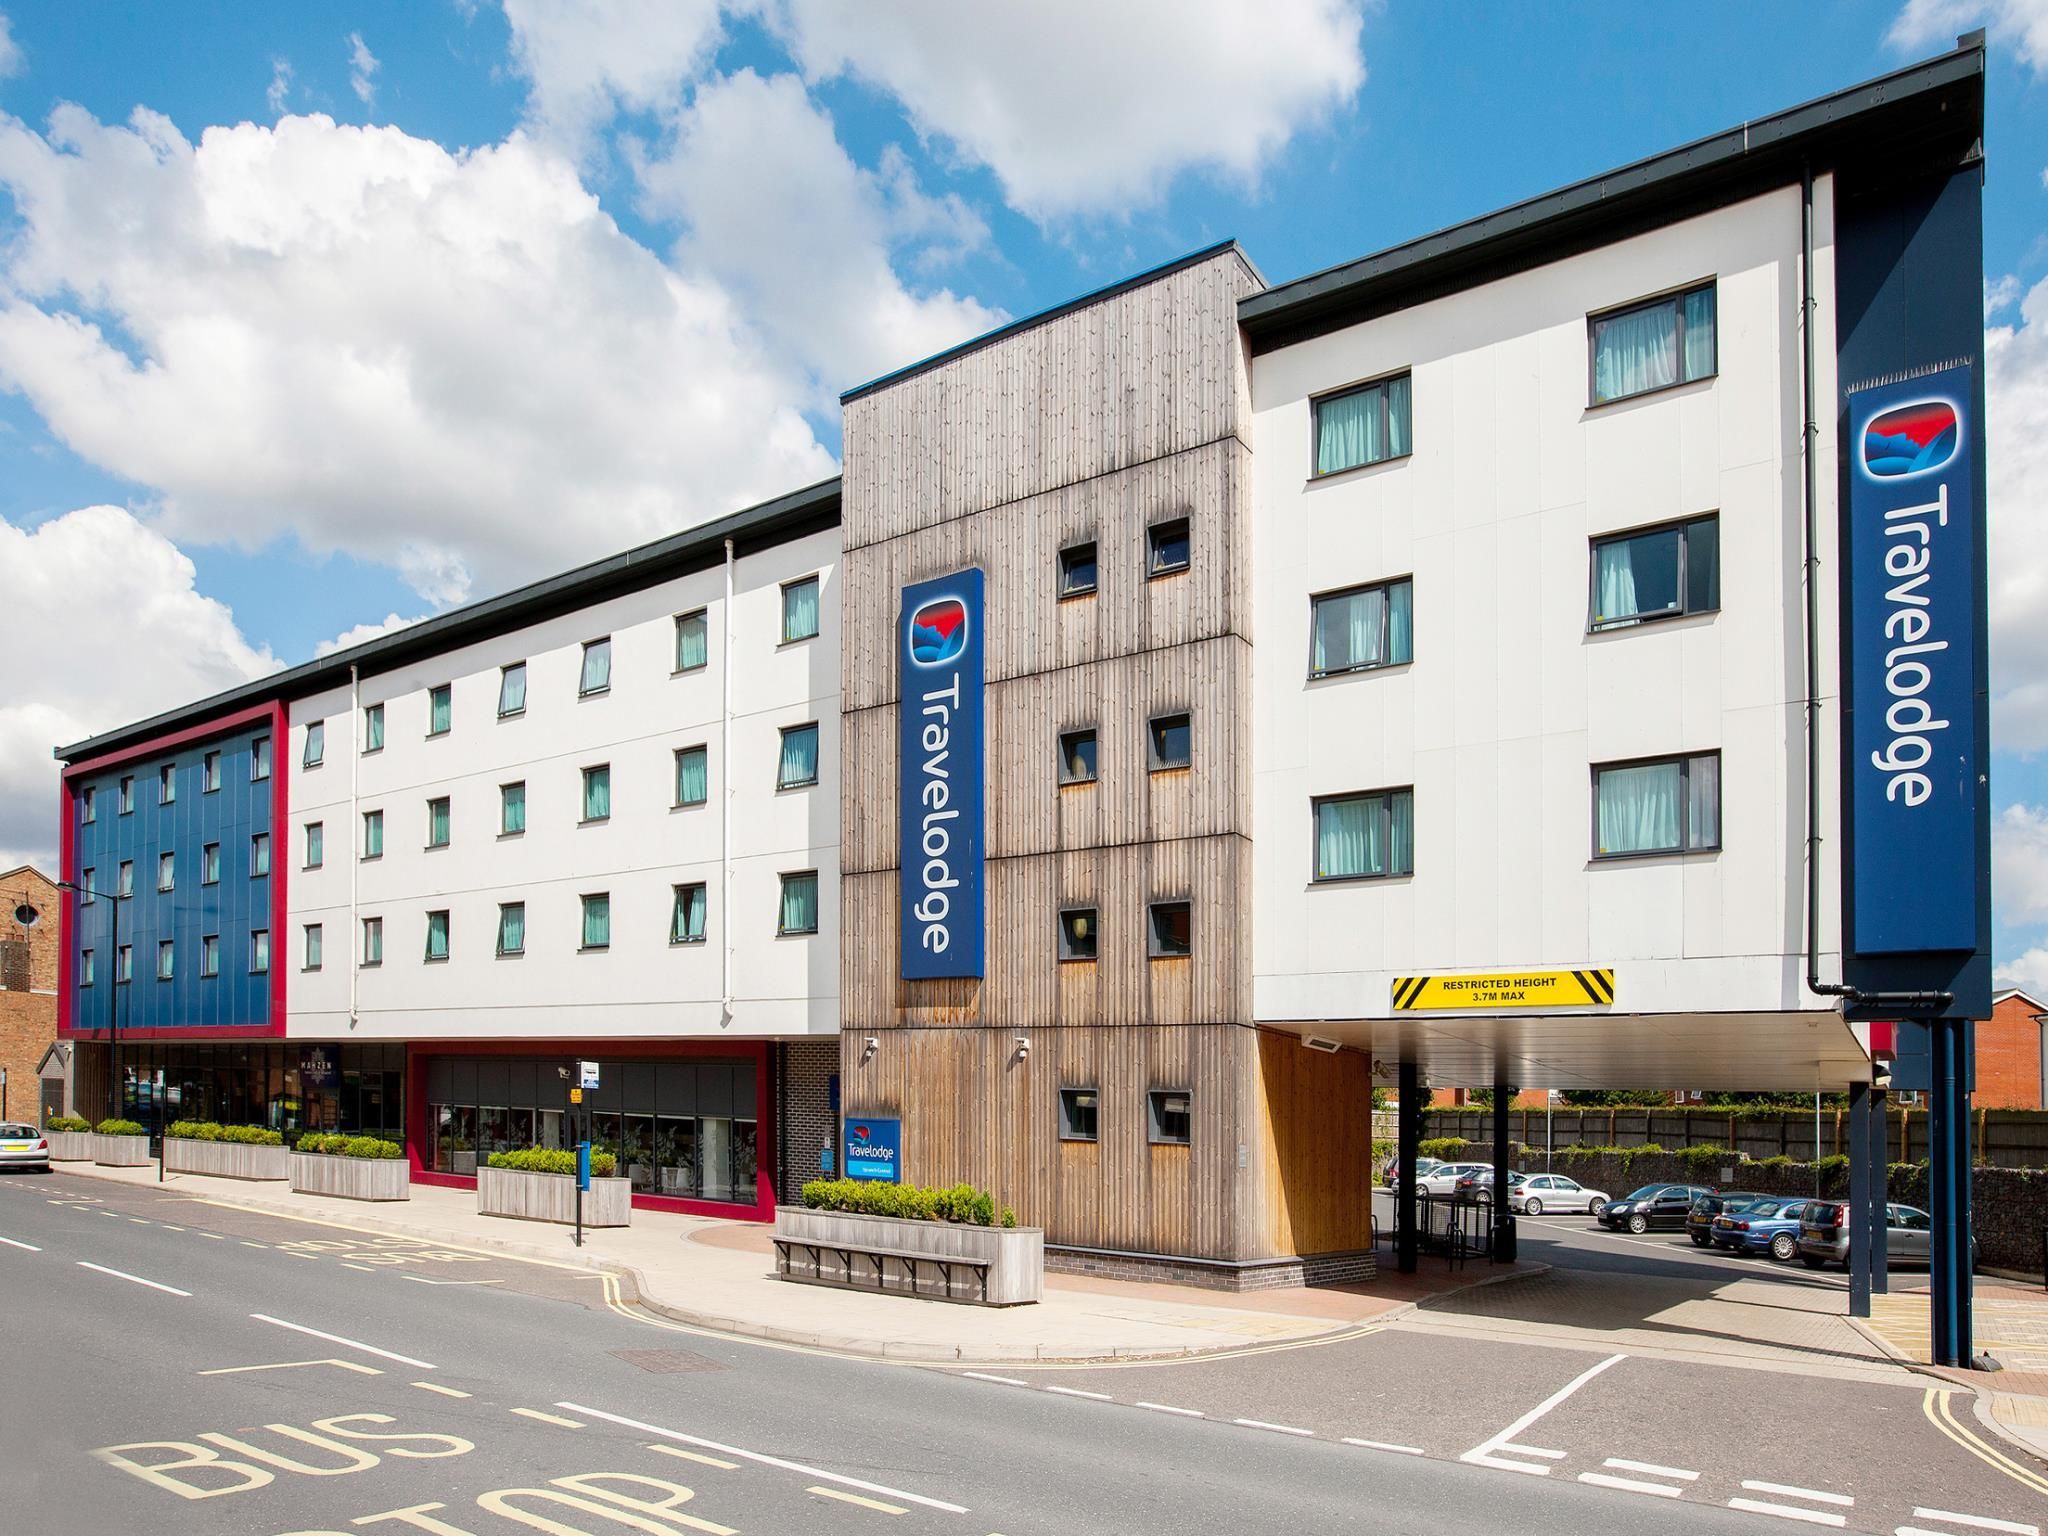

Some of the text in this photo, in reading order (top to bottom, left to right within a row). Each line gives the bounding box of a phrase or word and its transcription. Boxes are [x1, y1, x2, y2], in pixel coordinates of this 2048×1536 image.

[1873, 484, 1949, 807] Travelodge
[914, 672, 960, 954] Travelodge
[1443, 978, 1557, 990] RESTRICTED HEIGHT
[1473, 992, 1525, 1001] 3.7M MAX
[848, 1142, 894, 1161] Travelodge
[88, 1413, 475, 1499] BUS
[270, 1472, 742, 1536] TOP
